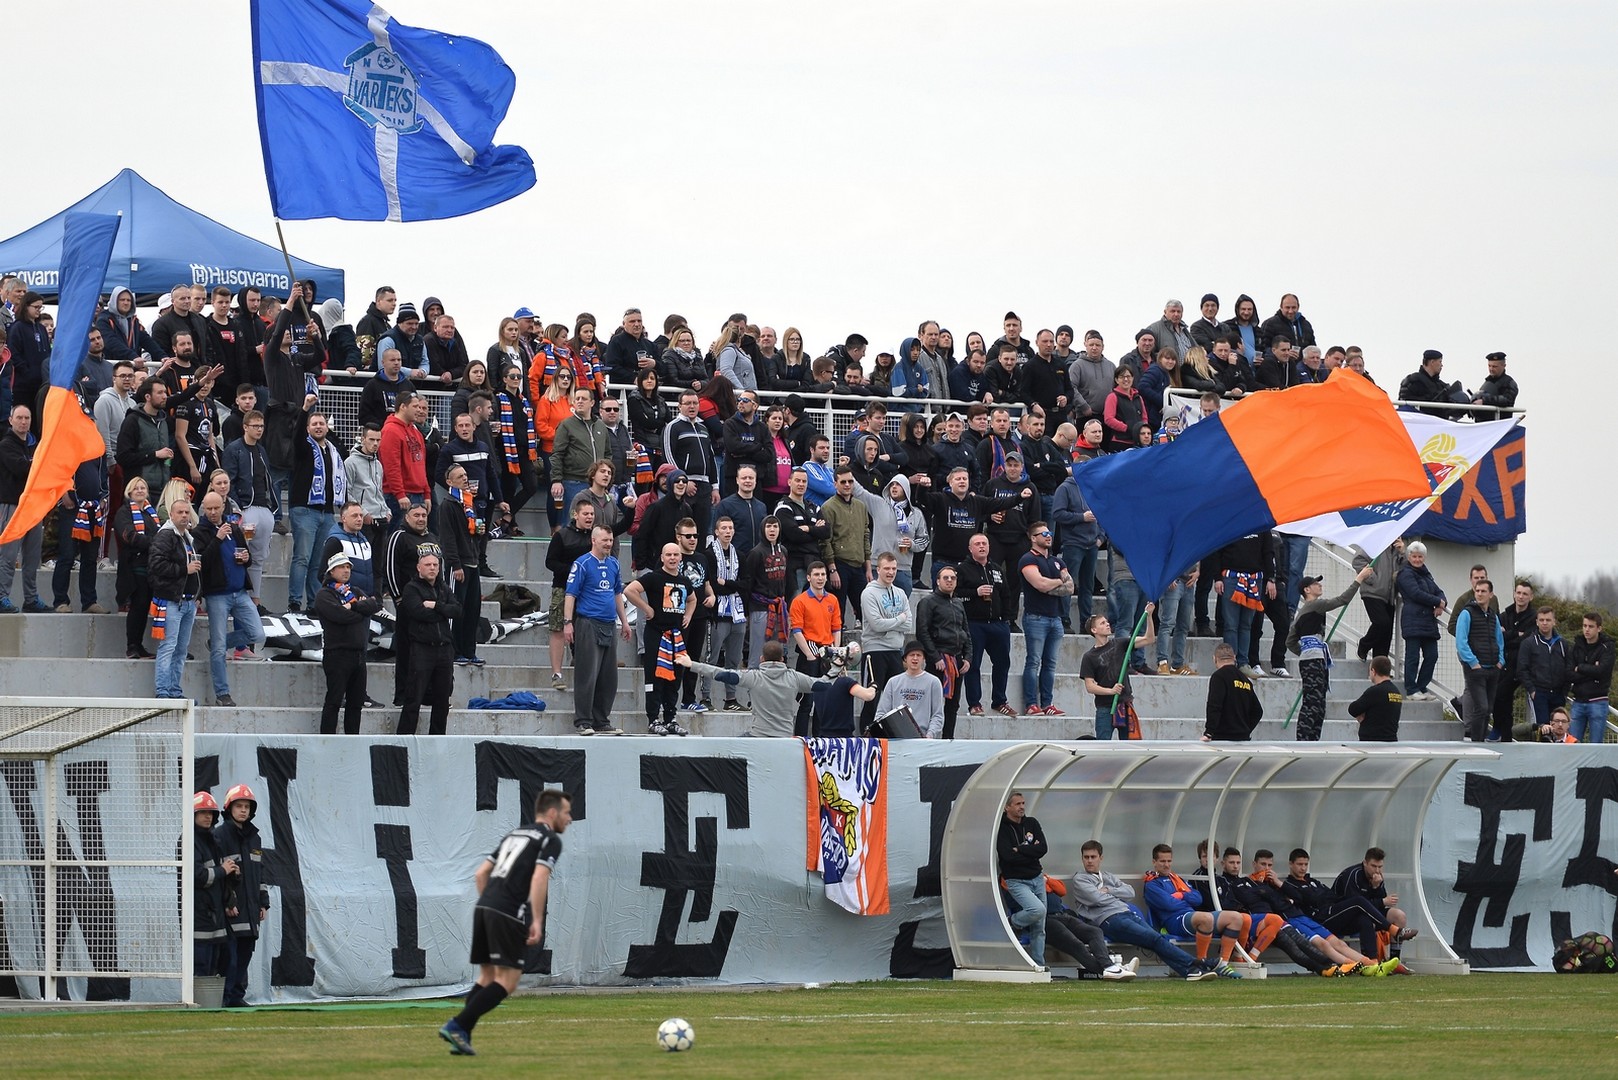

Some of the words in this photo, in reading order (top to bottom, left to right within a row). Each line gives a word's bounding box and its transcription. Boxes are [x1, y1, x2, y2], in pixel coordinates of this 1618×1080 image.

[363, 57, 371, 67] N
[400, 66, 407, 75] K
[354, 72, 413, 114] VARTEKS
[207, 266, 289, 290] Husqvarna
[835, 813, 843, 827] K
